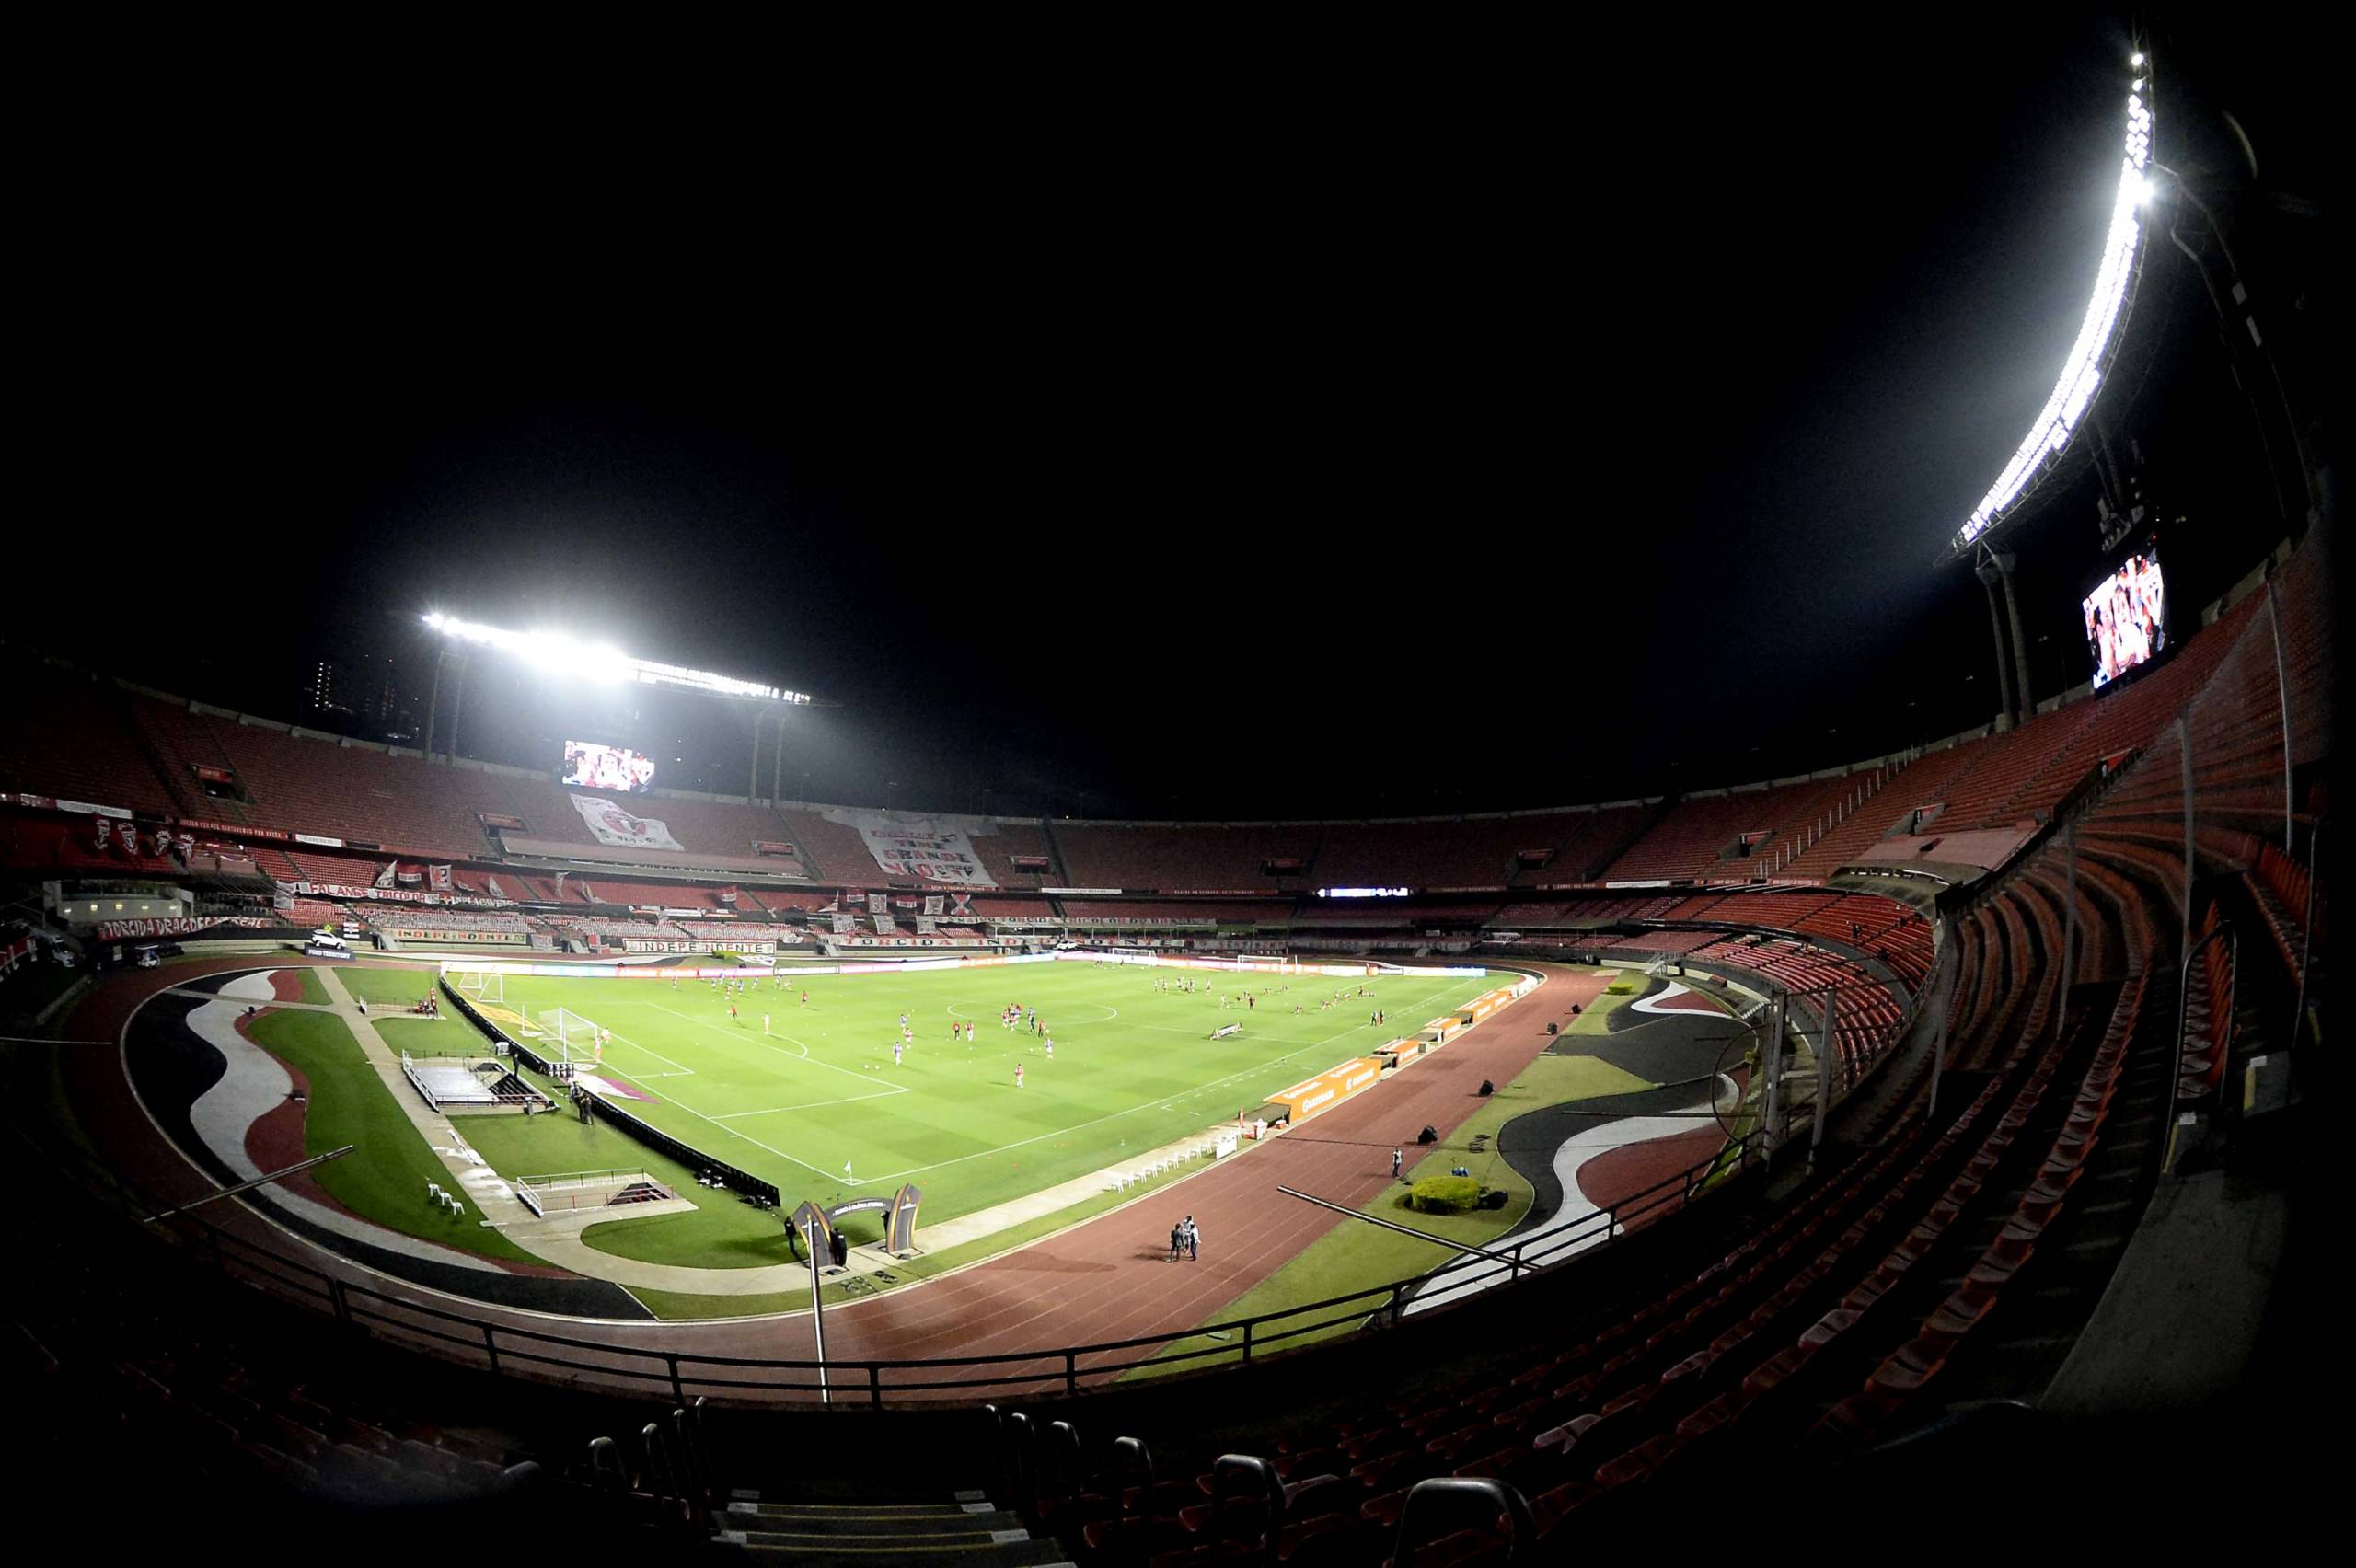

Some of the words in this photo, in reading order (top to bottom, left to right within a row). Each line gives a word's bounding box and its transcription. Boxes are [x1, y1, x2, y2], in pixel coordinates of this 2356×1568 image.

[309, 883, 368, 899] FALANGE
[375, 890, 426, 903] TRICOLOR
[104, 919, 154, 937] TORCIDA
[398, 929, 509, 941] INDEPENDENTE
[638, 941, 764, 953] INDEPENDENTE
[844, 938, 953, 946] TORCIDA
